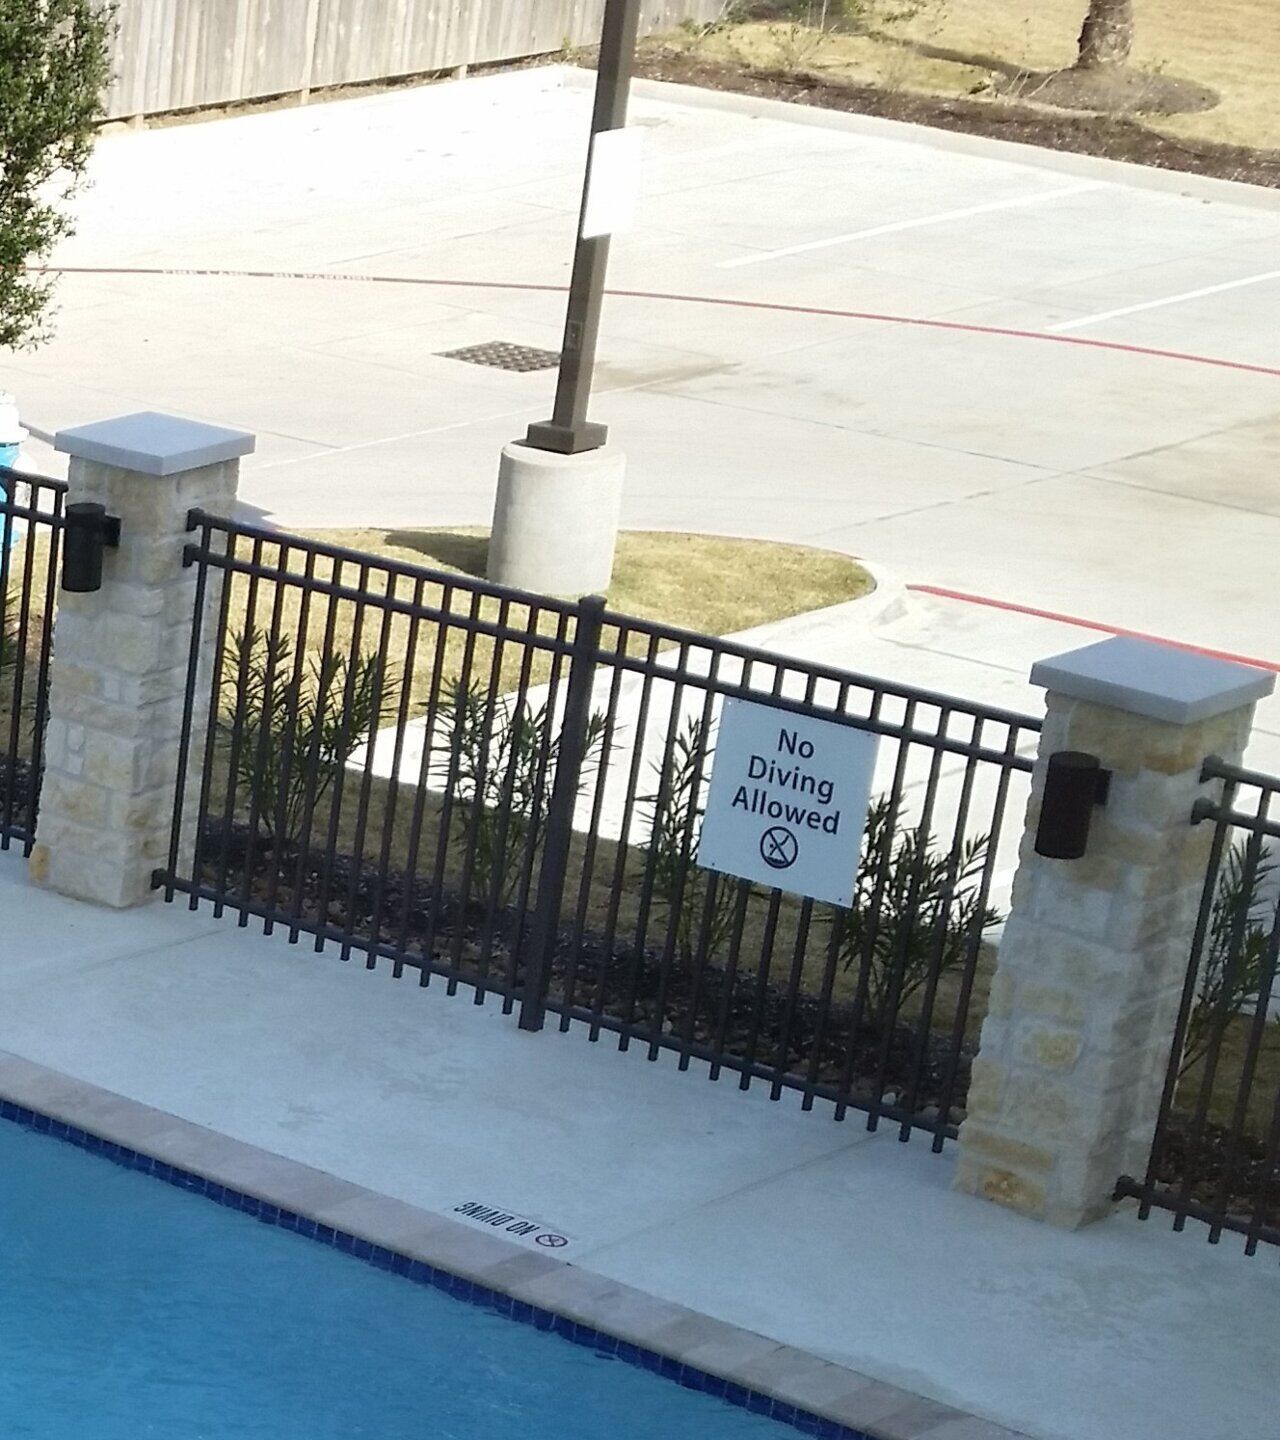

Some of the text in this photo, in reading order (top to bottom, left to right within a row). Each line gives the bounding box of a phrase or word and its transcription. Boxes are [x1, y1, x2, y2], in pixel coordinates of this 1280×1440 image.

[777, 728, 815, 759] No
[748, 755, 835, 805] Diving
[731, 786, 841, 835] Allowed
[454, 1202, 541, 1236] NO DIVING
